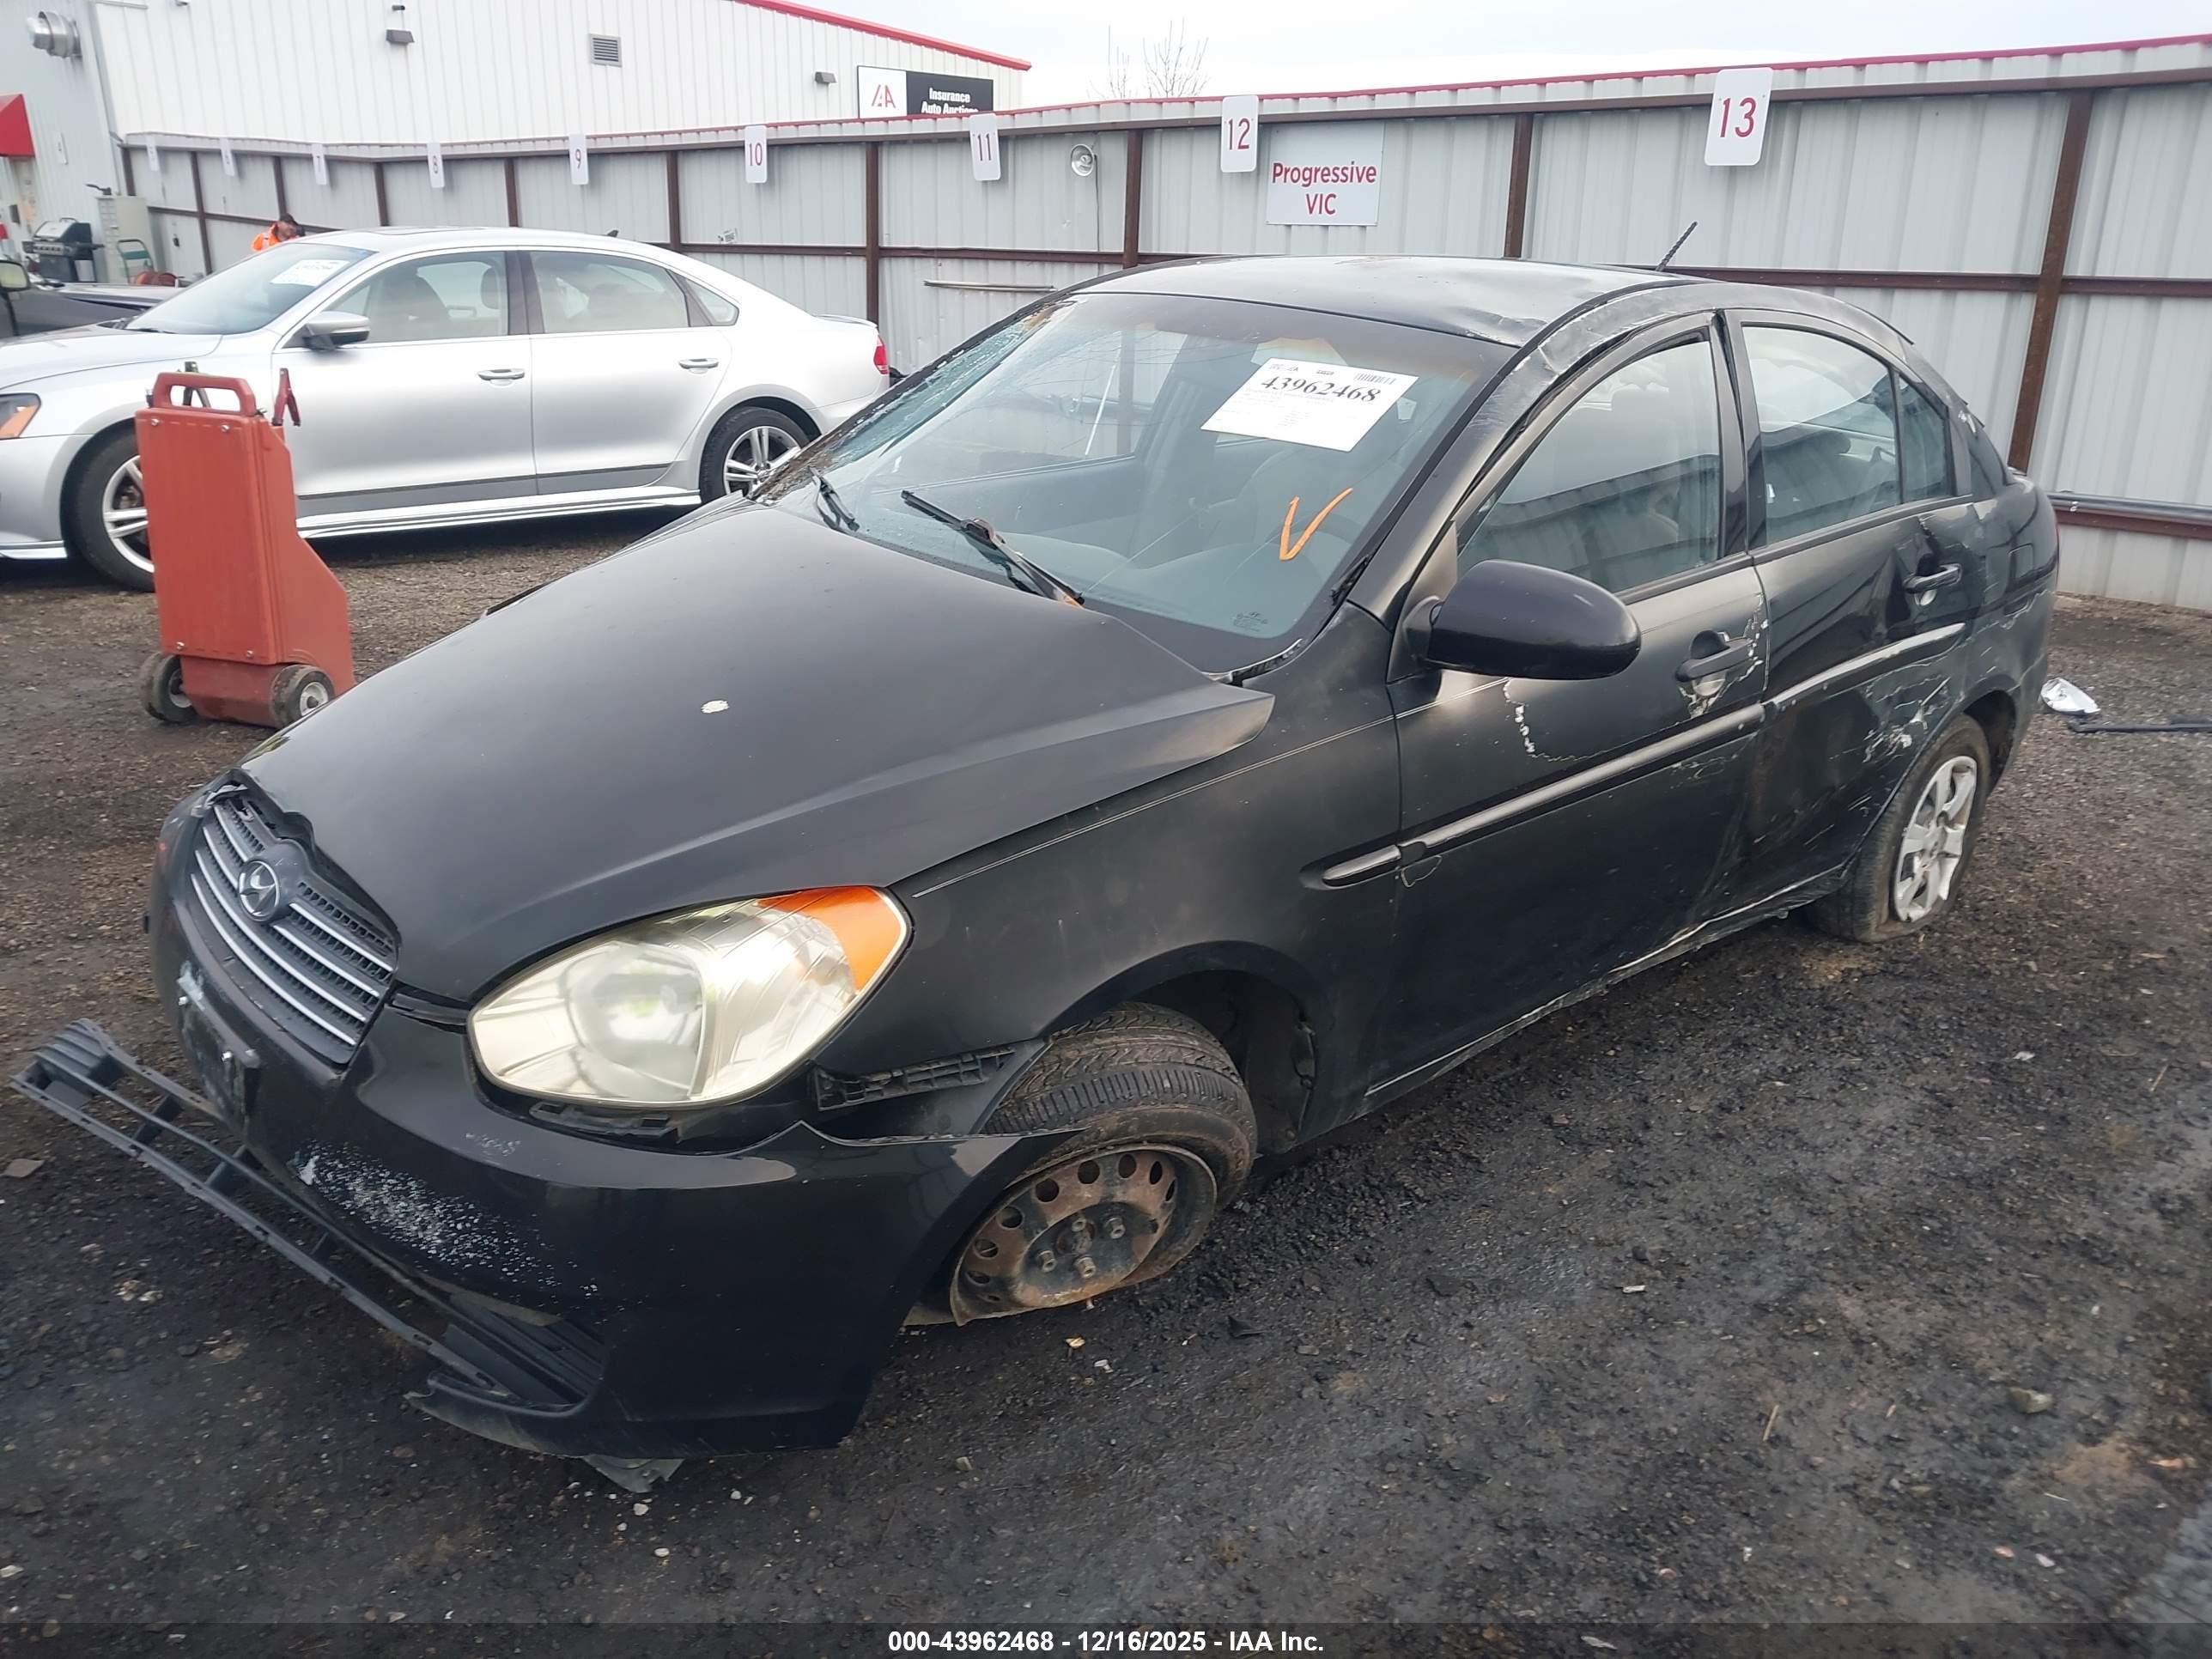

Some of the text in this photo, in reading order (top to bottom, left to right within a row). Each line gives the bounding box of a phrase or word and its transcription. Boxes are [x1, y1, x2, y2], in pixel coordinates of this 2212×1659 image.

[921, 100, 941, 114] Auto
[929, 87, 970, 103] Insurance
[1720, 97, 1757, 137] 13
[1227, 118, 1250, 150] 12
[575, 149, 581, 169] 9
[749, 143, 763, 166] 10
[977, 133, 992, 161] 11
[1272, 161, 1376, 187] Progressive
[1305, 193, 1337, 215] VIC
[1261, 376, 1382, 402] 43962468
